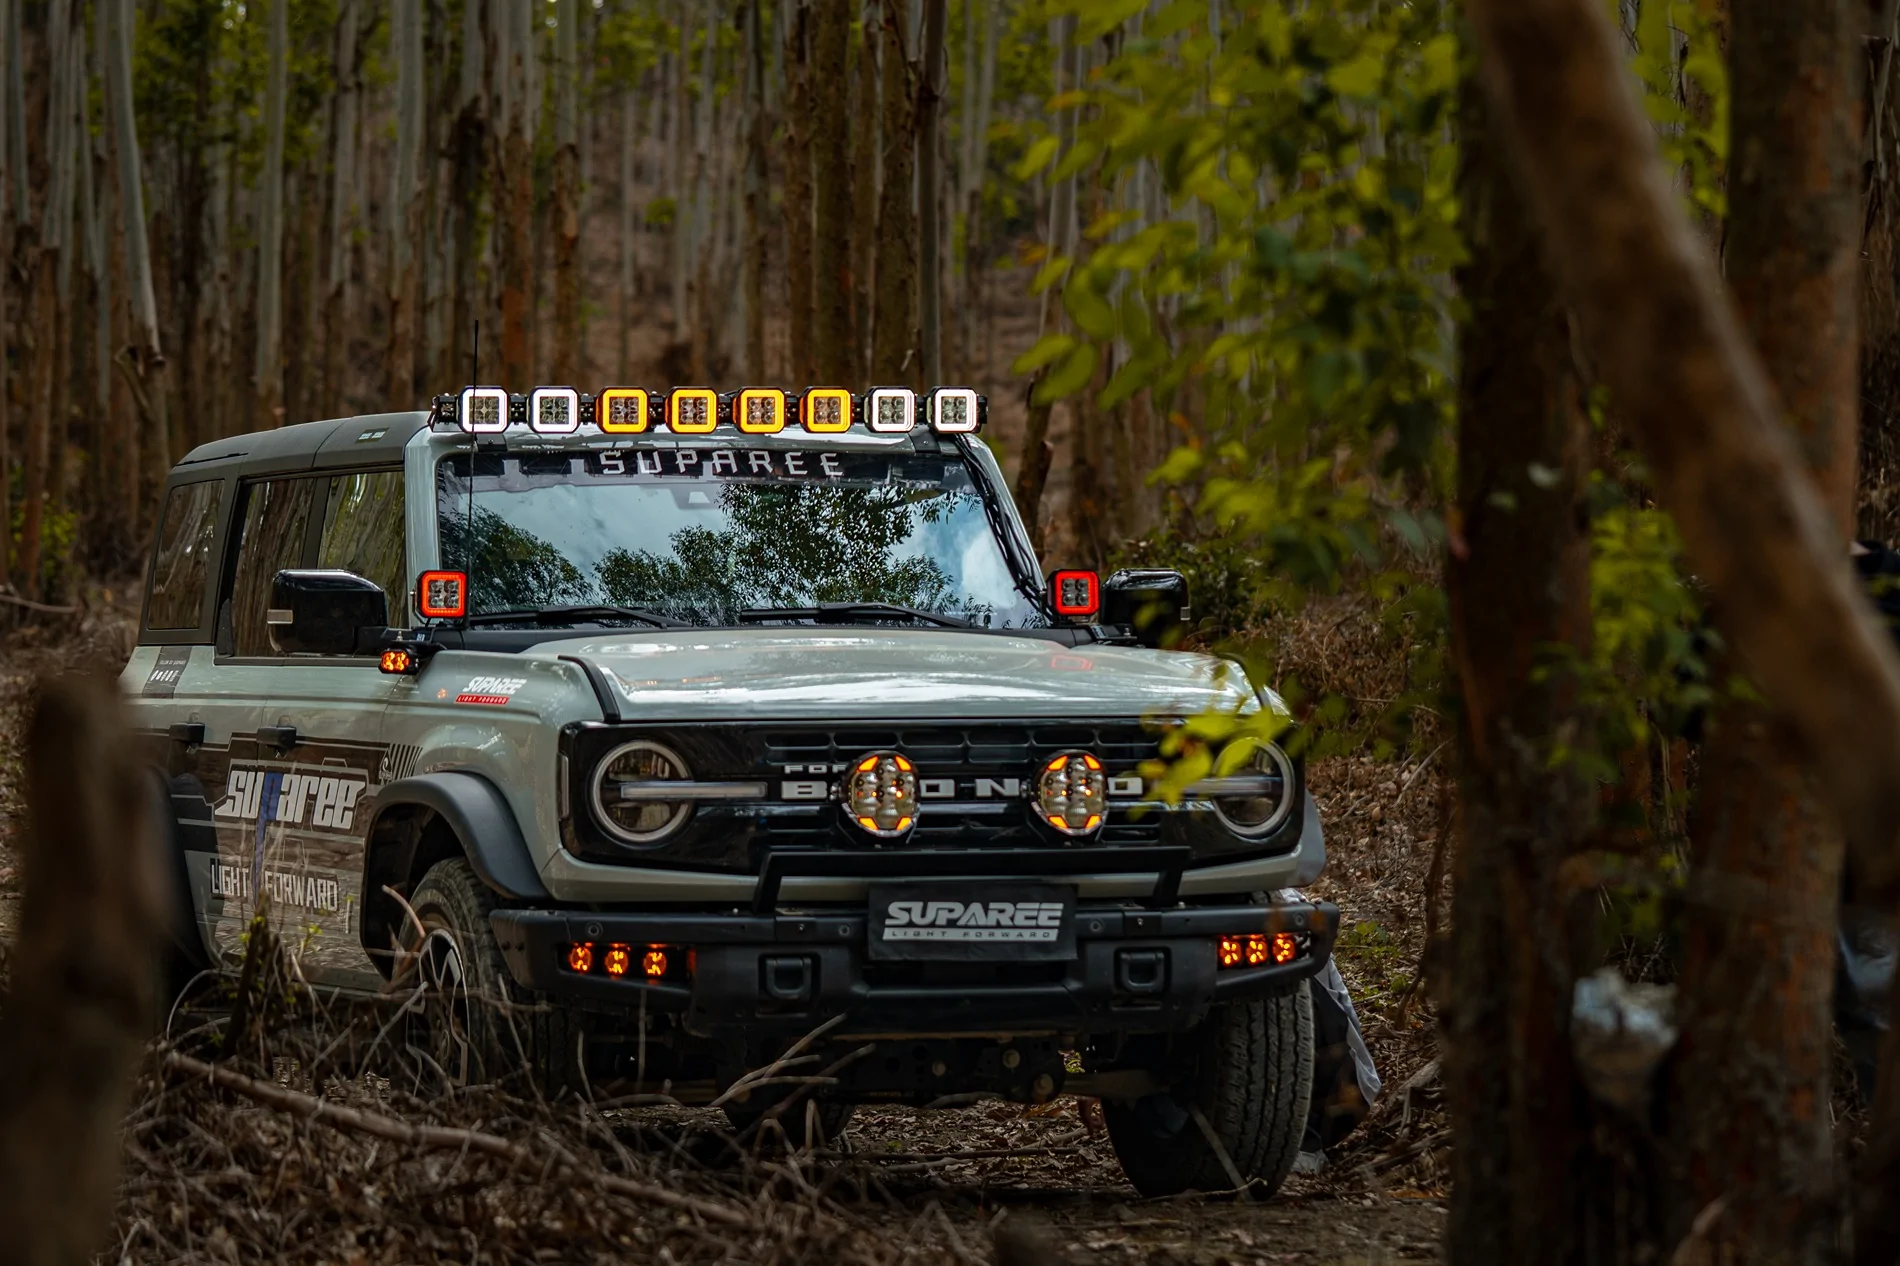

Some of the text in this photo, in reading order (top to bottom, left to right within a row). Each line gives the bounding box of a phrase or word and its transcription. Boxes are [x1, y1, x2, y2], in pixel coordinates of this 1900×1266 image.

[599, 450, 844, 477] SUPAREE
[462, 676, 528, 695] SUPAREE
[211, 864, 339, 912] LIGHT FORWARD
[885, 901, 1064, 927] SUPAREE
[892, 930, 1051, 939] LIGHT FORWARD
